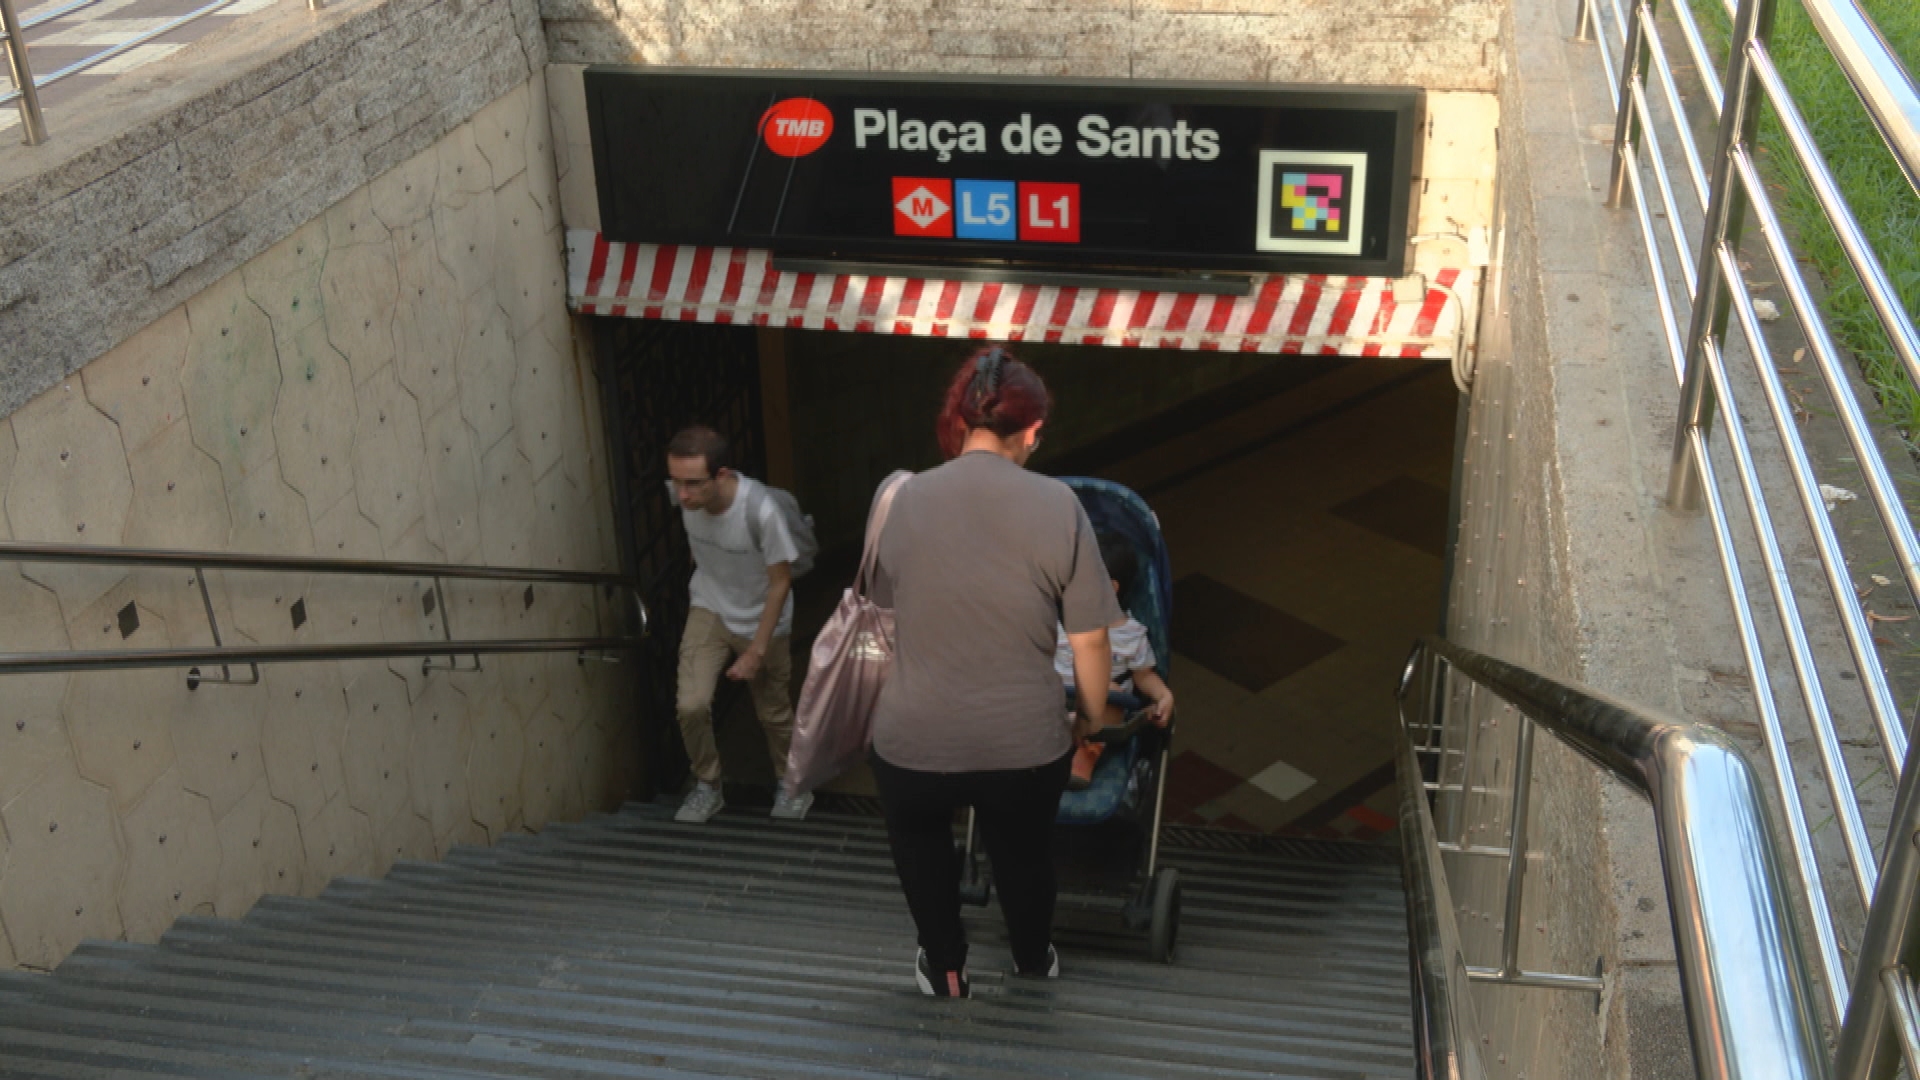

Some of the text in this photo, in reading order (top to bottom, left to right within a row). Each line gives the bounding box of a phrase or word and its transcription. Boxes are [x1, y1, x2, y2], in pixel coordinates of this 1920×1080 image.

[775, 118, 826, 138] TMB
[853, 107, 1221, 163] Plaça de Sants
[911, 191, 1070, 229] M L5 L1
